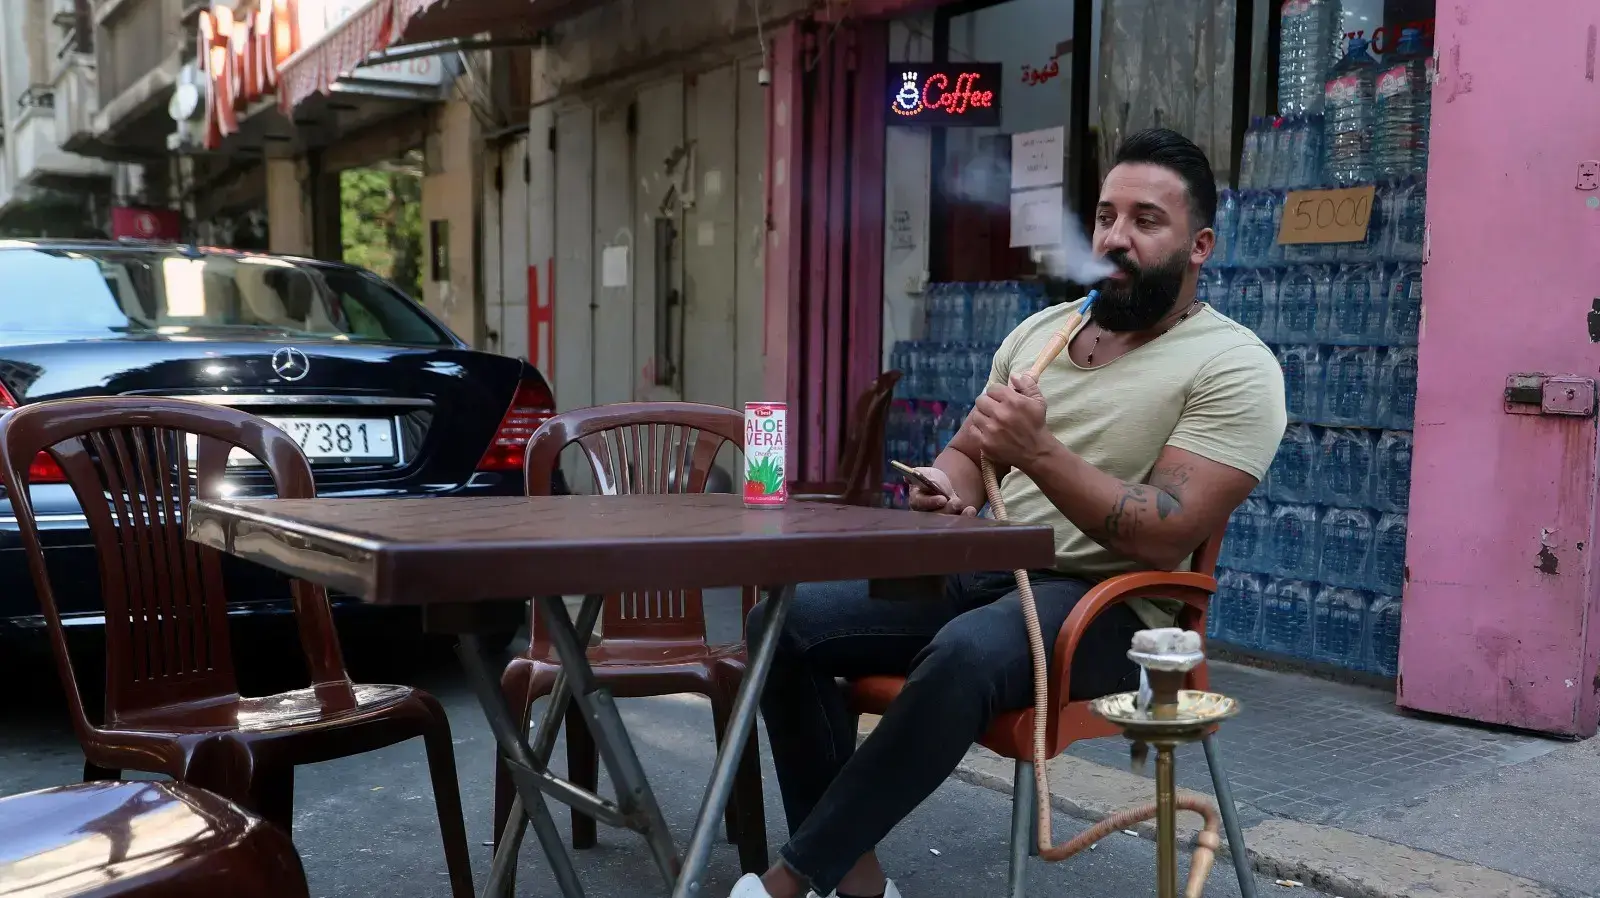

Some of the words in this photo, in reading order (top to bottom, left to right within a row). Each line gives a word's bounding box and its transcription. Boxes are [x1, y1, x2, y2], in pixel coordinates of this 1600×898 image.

[1020, 56, 1059, 86] قهوة
[922, 72, 993, 114] Coffee
[1294, 195, 1368, 231] 5000
[277, 421, 370, 454] 7381
[746, 418, 783, 433] ALOE
[746, 432, 783, 446] VERA
